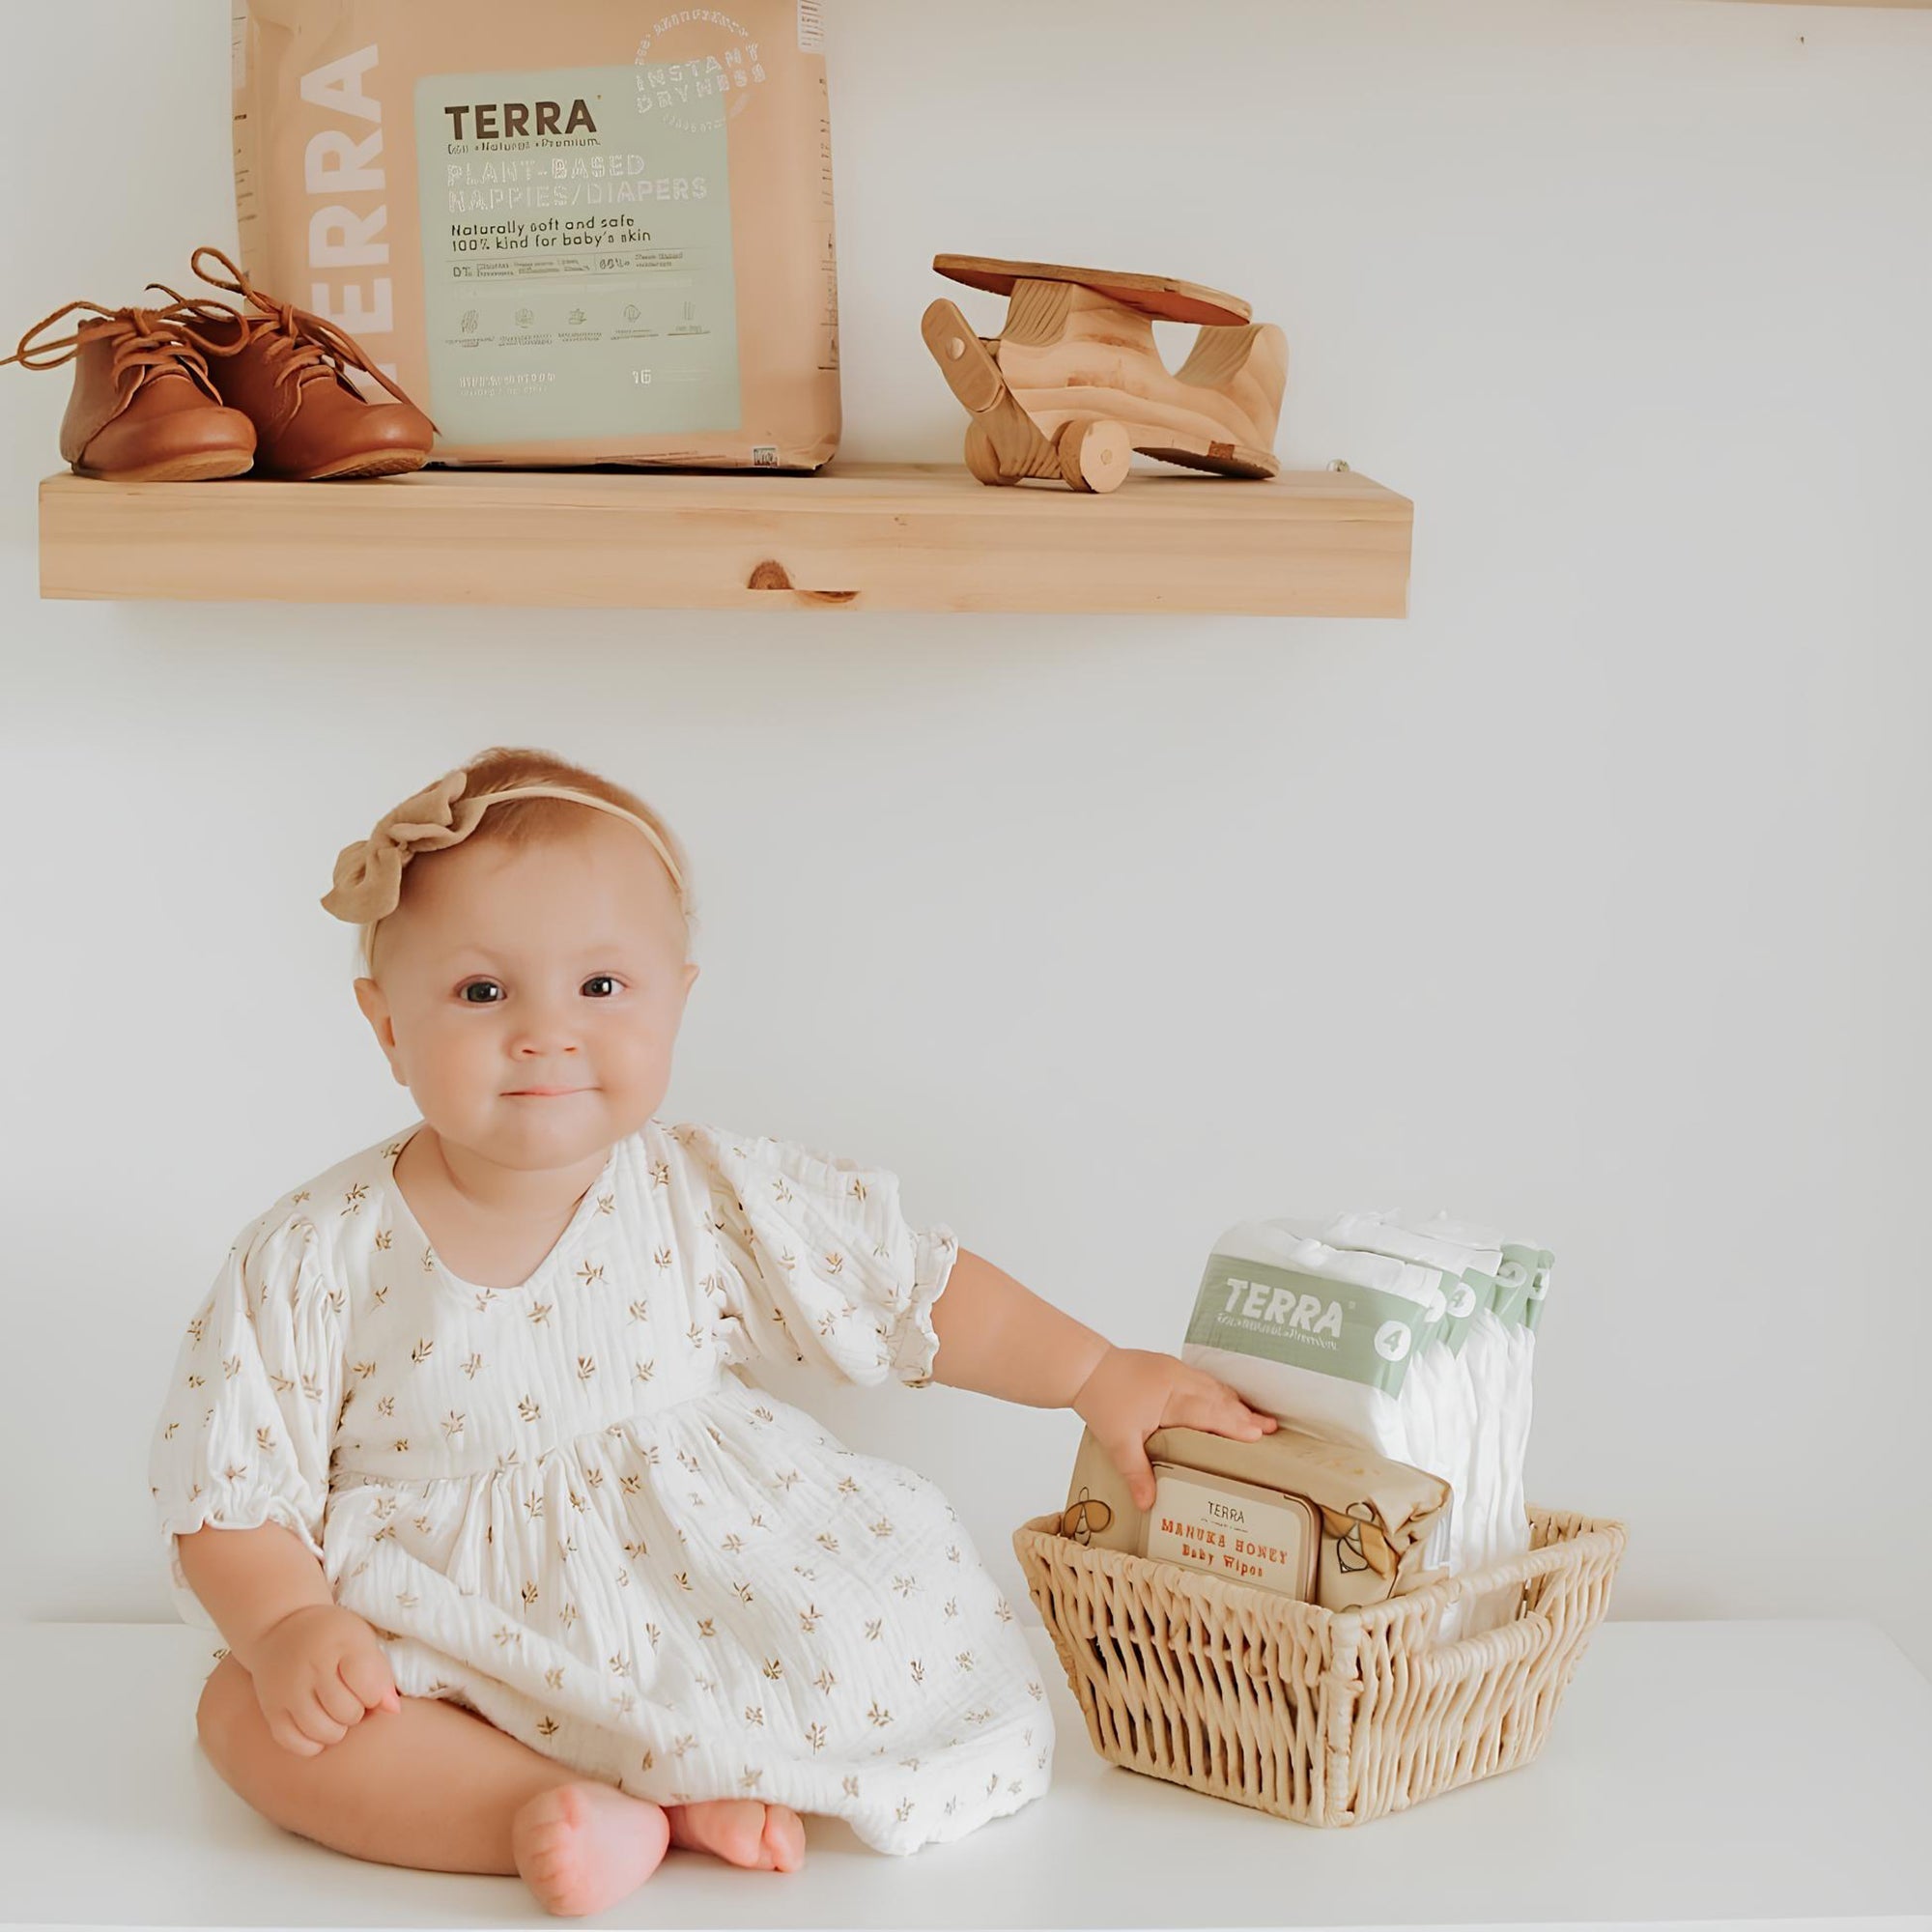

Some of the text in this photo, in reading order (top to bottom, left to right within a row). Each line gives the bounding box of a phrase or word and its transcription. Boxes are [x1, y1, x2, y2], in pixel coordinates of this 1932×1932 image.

[443, 99, 598, 141] TERRA
[450, 219, 526, 237] Naturally
[565, 215, 595, 230] and
[452, 238, 490, 252] 100%
[496, 235, 528, 250] kind
[535, 235, 557, 247] for
[1226, 1277, 1344, 1338] TERRA
[1208, 1501, 1245, 1524] TERRA
[1161, 1518, 1227, 1548] MANUKA
[1235, 1539, 1288, 1565] HONEY
[1181, 1543, 1215, 1566] Baby
